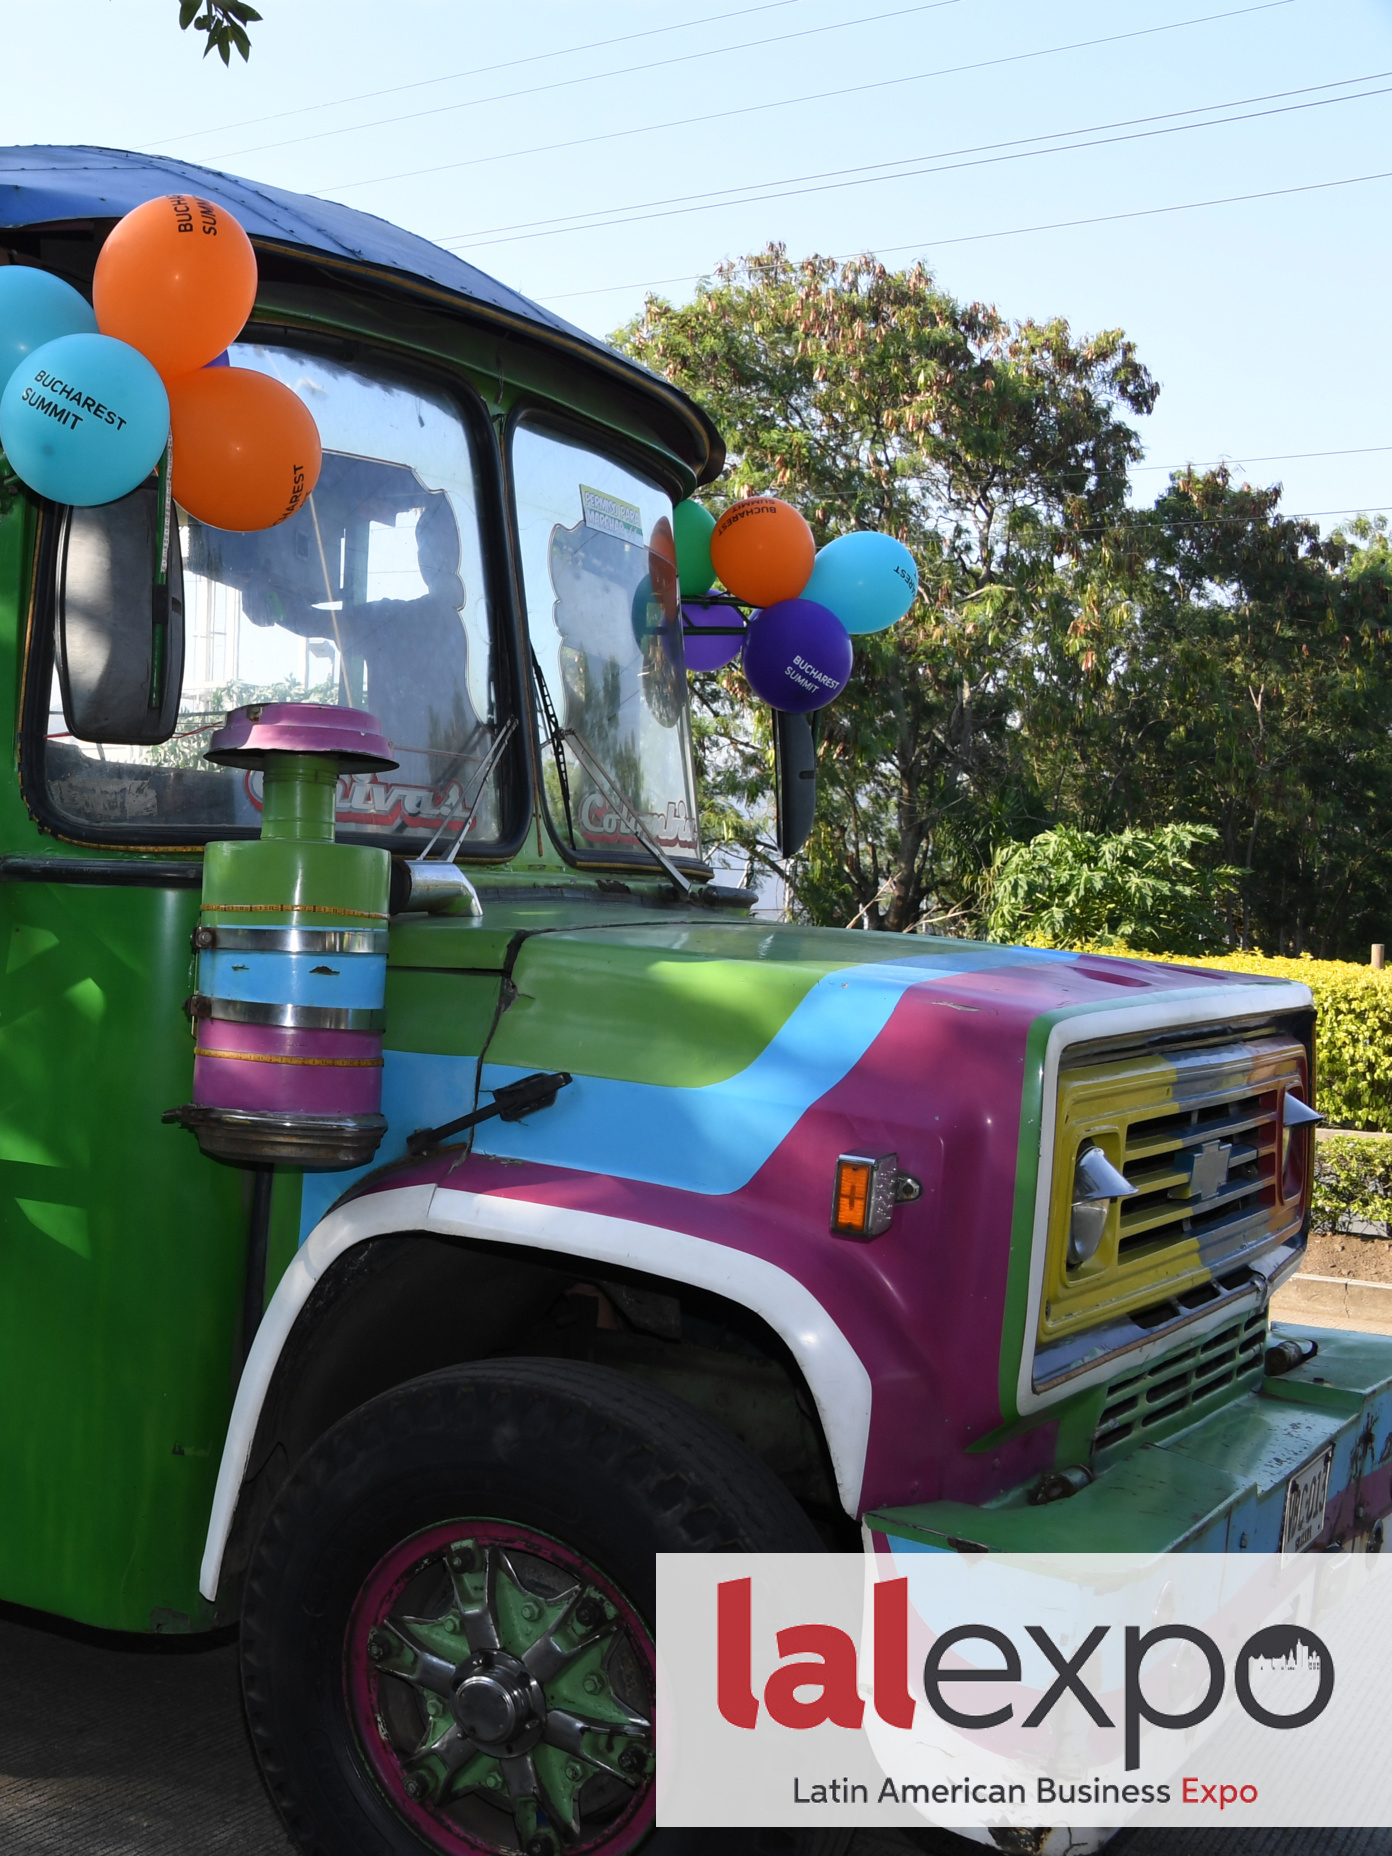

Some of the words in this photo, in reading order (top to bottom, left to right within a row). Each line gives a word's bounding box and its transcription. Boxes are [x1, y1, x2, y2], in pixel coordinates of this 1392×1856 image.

[22, 388, 84, 430] SUMMIT
[35, 370, 127, 431] BUCHAREST
[718, 506, 777, 537] BUCHAREST
[784, 666, 820, 694] SUMMIT
[792, 655, 840, 690] BUCHAREST
